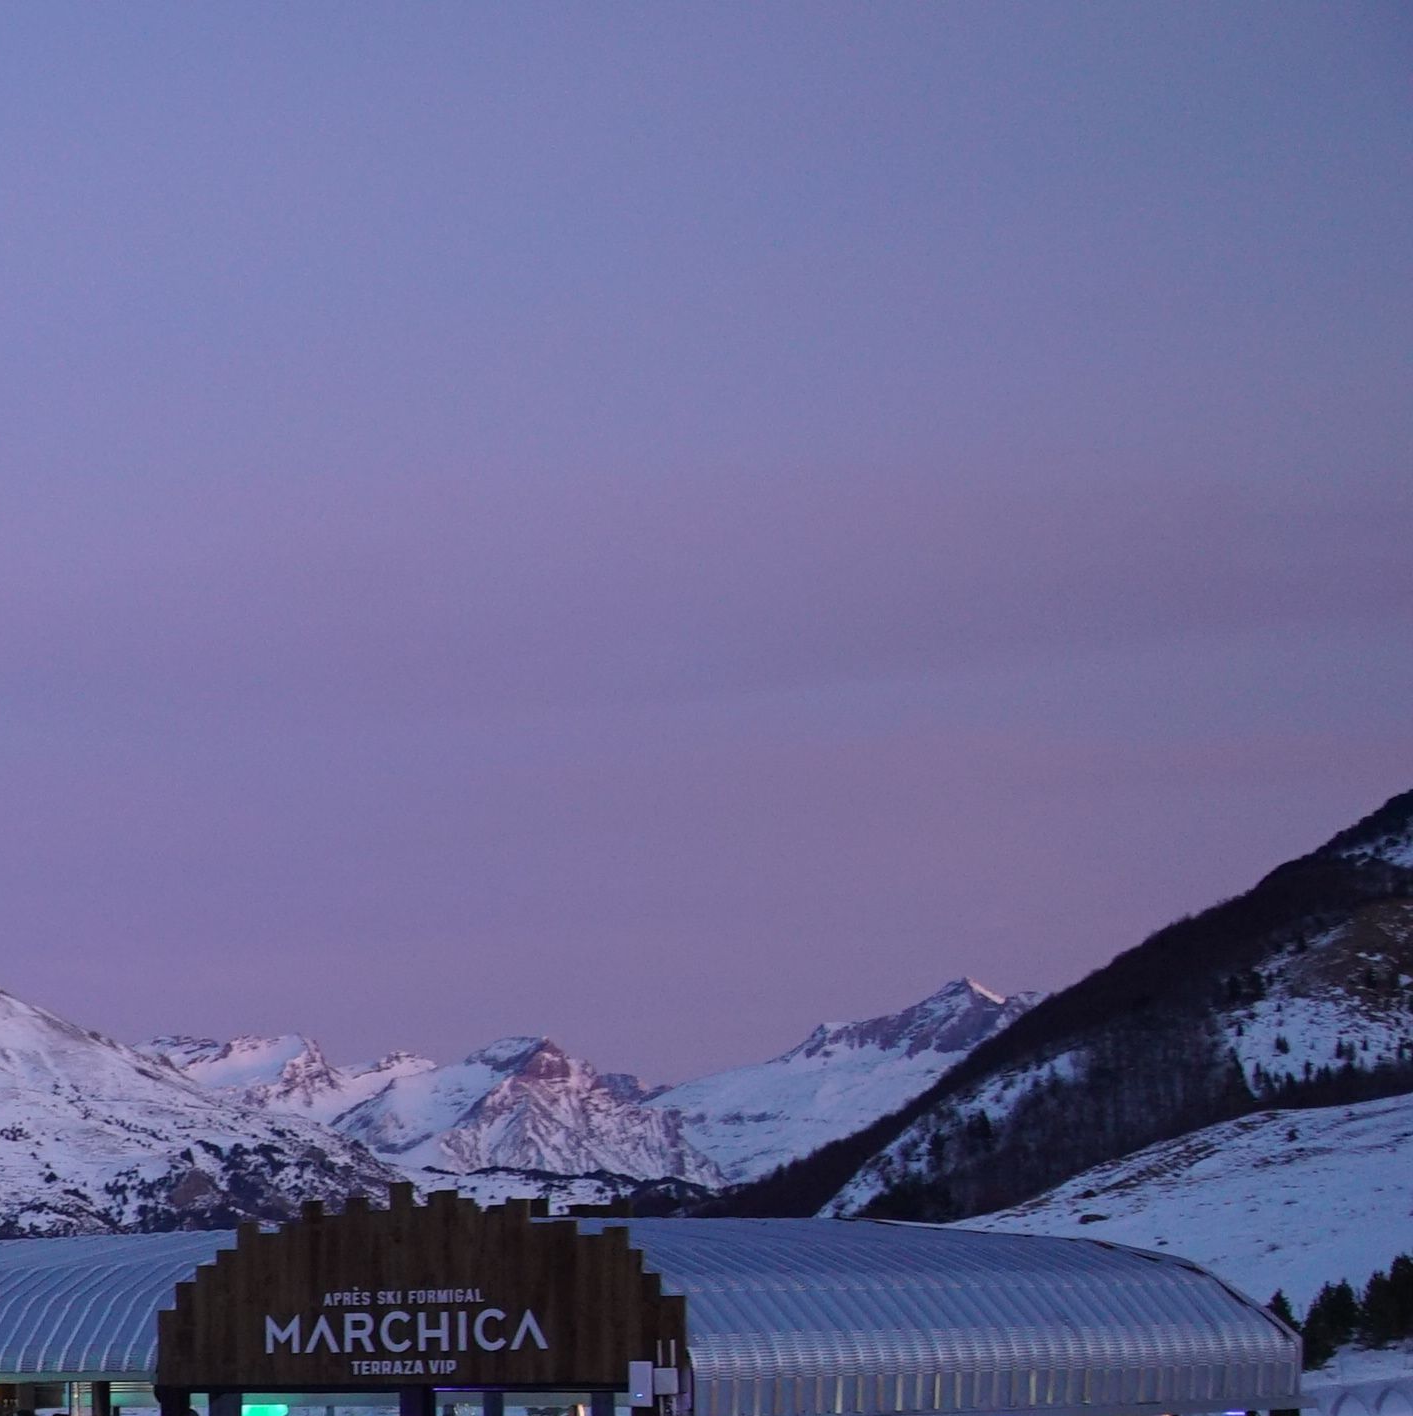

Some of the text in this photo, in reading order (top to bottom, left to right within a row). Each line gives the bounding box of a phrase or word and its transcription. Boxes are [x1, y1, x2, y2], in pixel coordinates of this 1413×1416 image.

[323, 1286, 485, 1307] APRÈS SKI FORMIGAL
[264, 1308, 549, 1355] MARCHICA
[351, 1359, 457, 1376] TERRAZA VIP
